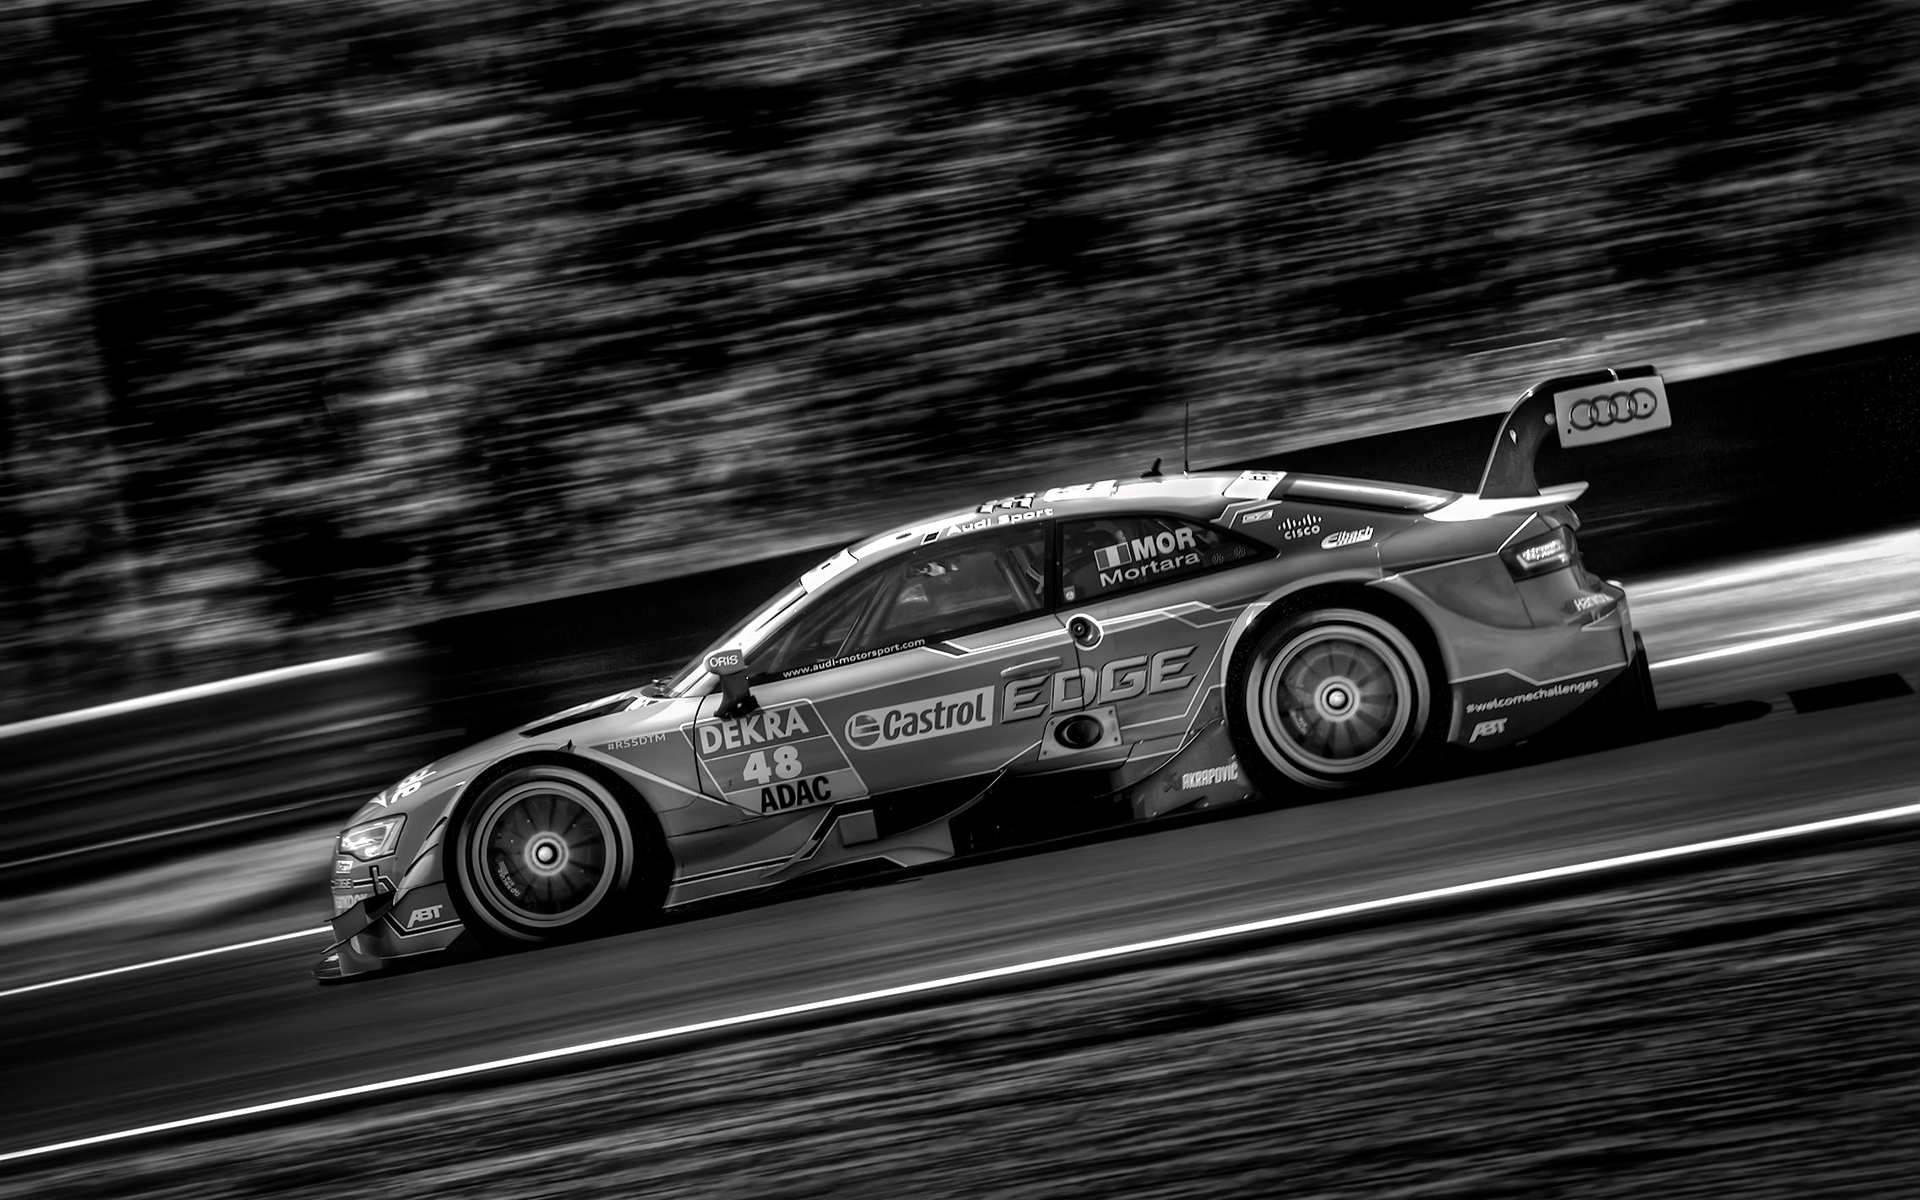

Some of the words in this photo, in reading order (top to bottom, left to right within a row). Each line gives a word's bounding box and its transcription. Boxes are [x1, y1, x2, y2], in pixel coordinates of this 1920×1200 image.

[946, 518, 992, 536] Audi
[997, 507, 1054, 527] Sport
[1284, 525, 1320, 540] cisco
[1131, 527, 1196, 561] MOR
[1100, 552, 1200, 587] Mortara
[709, 655, 738, 668] ORIS
[783, 637, 925, 678] www.audi-motorsport.com
[1000, 644, 1198, 723] EDGE
[1466, 679, 1599, 714] #welcomechallenges
[699, 706, 809, 754] DEKRA
[883, 692, 986, 740] Castrol
[1469, 717, 1508, 743] ABT
[743, 745, 802, 784] 48
[761, 776, 831, 813] ADAC
[406, 904, 443, 928] ABT
